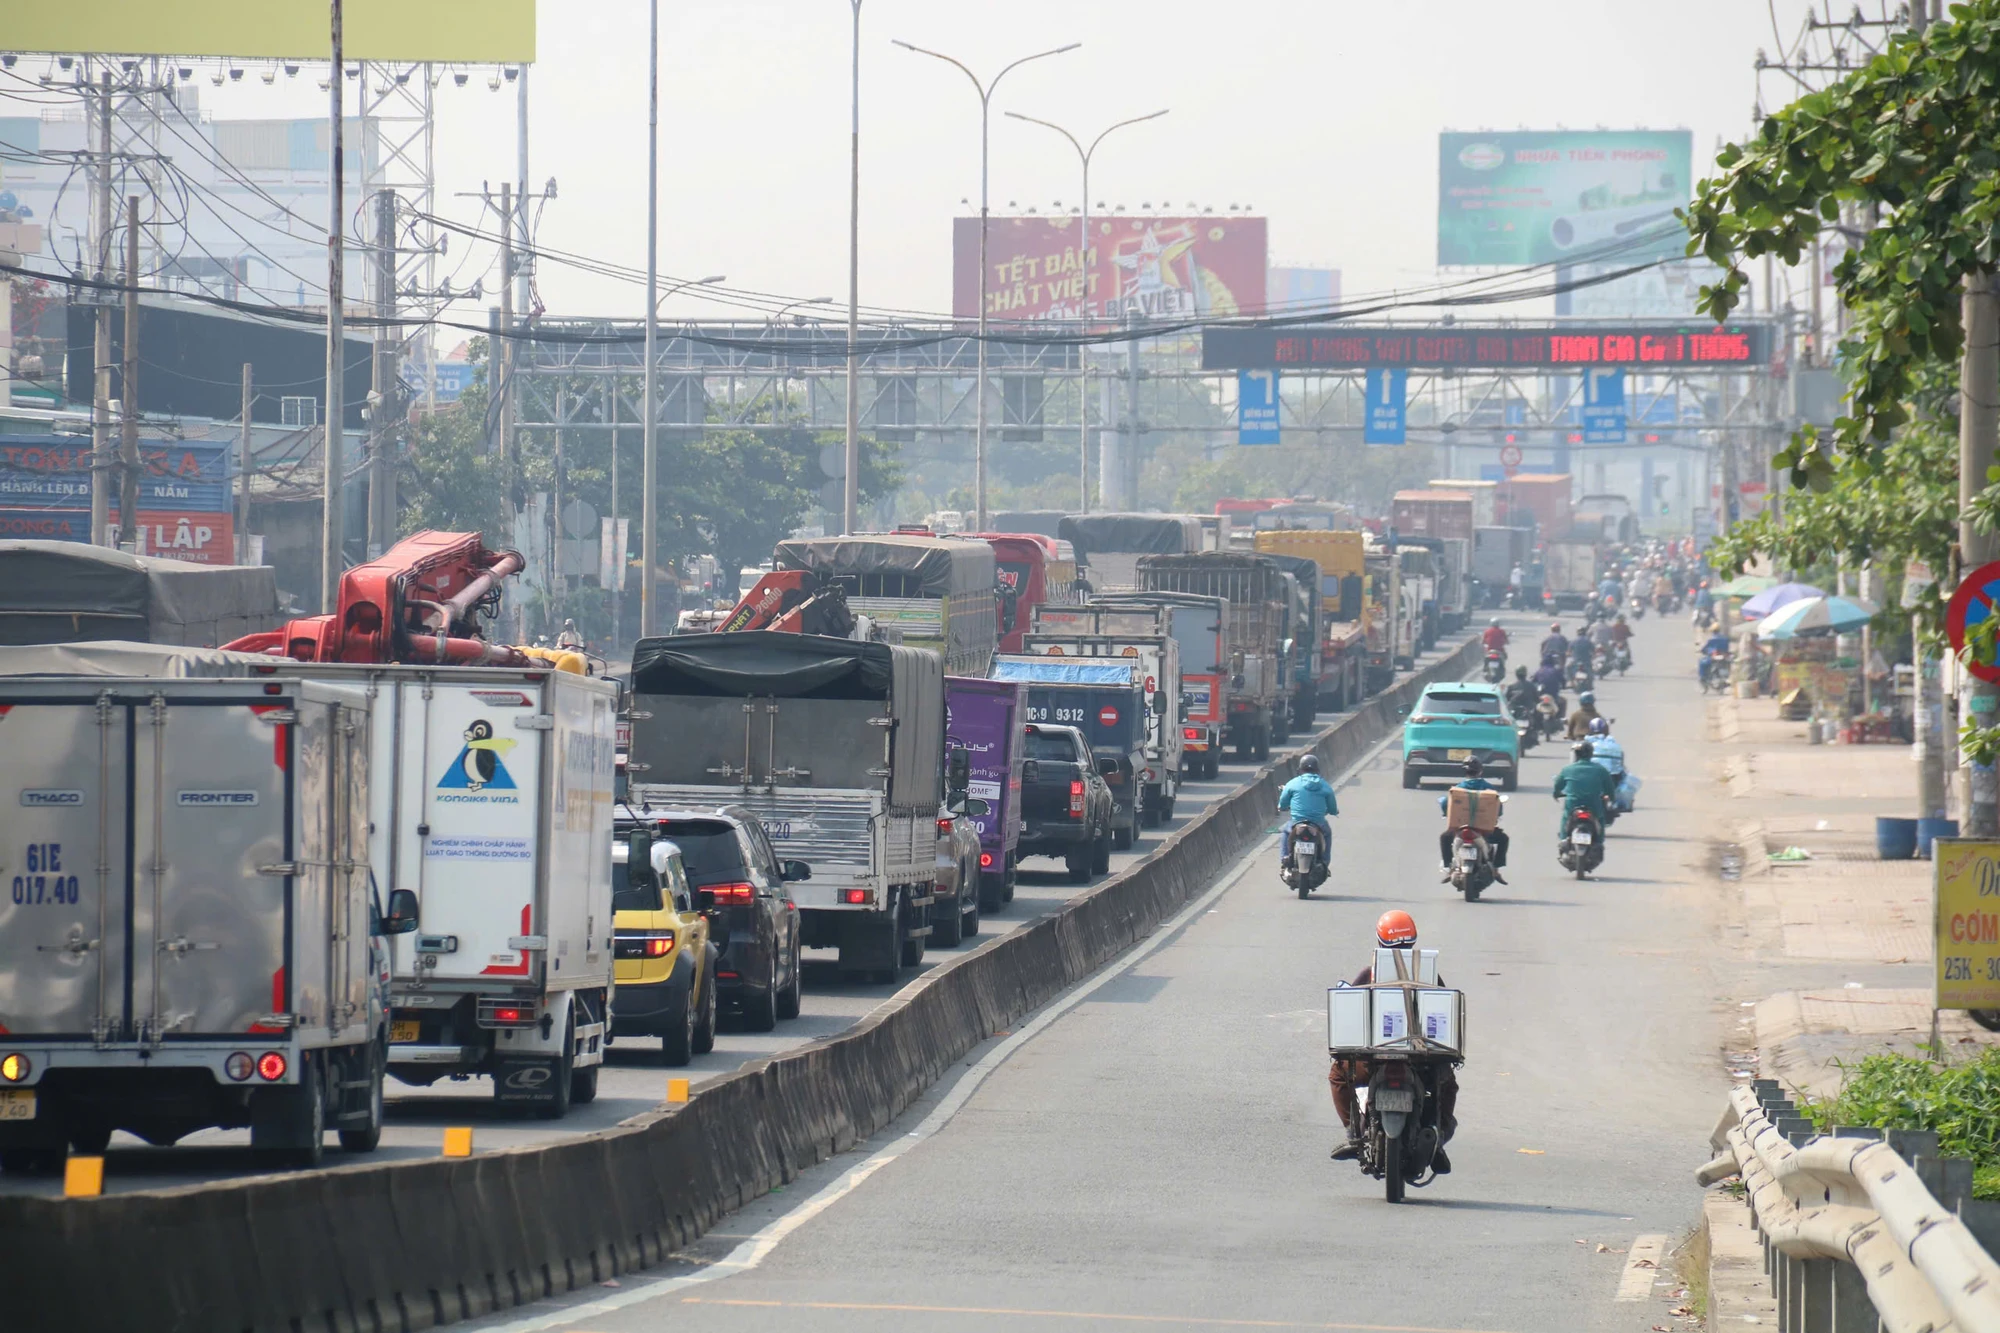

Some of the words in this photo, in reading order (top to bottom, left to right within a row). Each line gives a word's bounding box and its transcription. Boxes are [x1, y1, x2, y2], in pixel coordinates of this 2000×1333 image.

[995, 254, 1040, 284] TẾT
[1603, 335, 1635, 361] GIA
[154, 483, 189, 498] NĂM
[755, 587, 783, 614] 26000
[1041, 614, 1076, 623] ISUZU
[27, 793, 80, 803] THACO
[180, 793, 255, 803] FRONTIER
[26, 843, 62, 872] 61E
[12, 875, 80, 905] 017.40
[1950, 908, 1999, 945] CƠM
[1944, 956, 1973, 981] 25K
